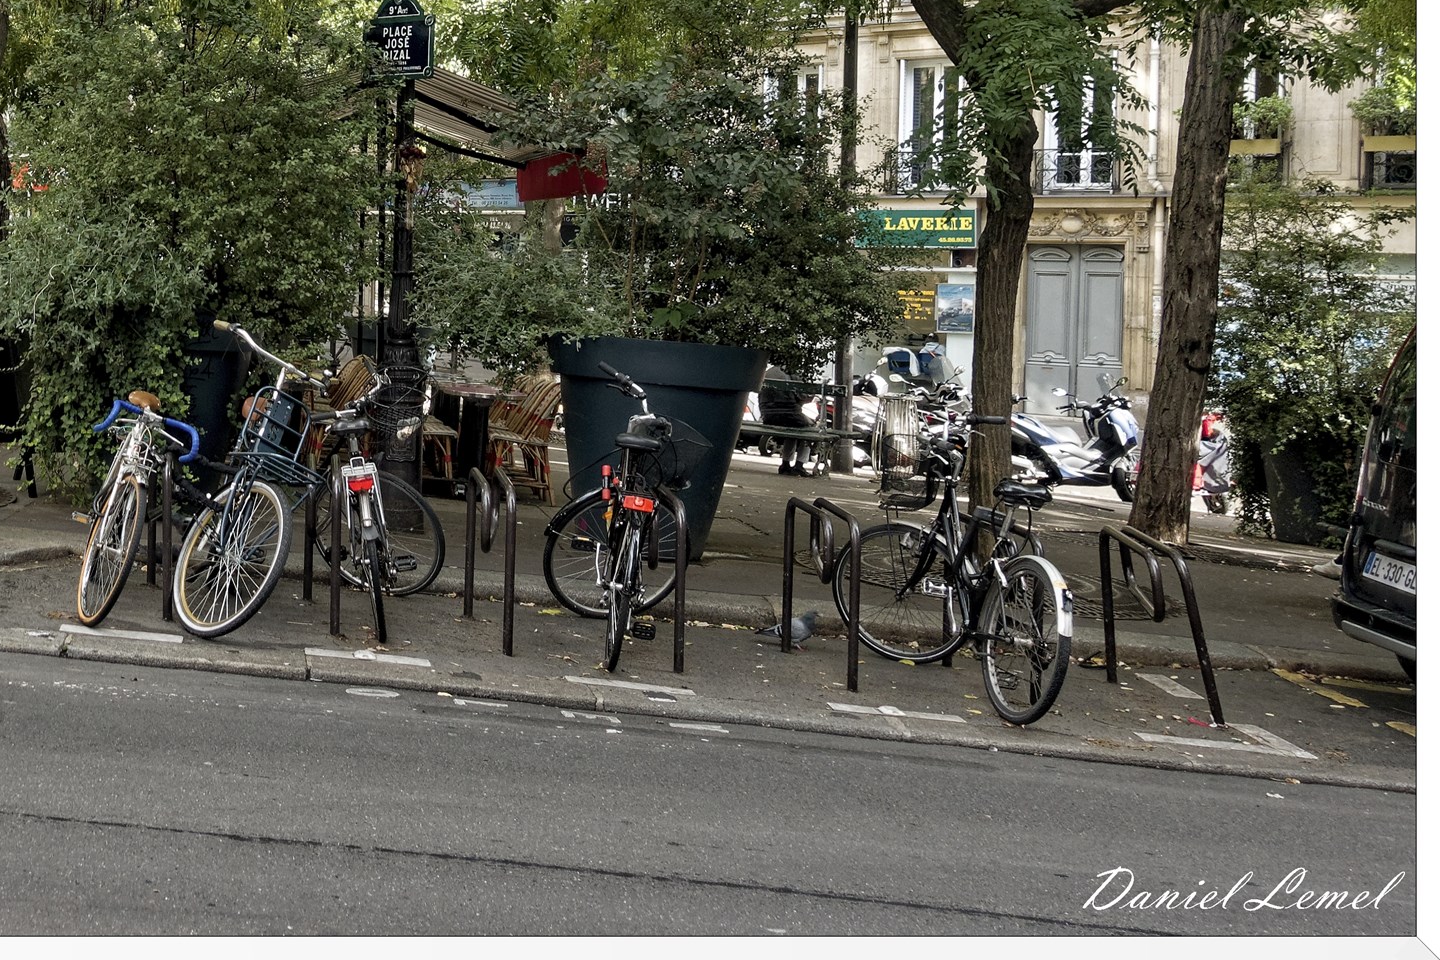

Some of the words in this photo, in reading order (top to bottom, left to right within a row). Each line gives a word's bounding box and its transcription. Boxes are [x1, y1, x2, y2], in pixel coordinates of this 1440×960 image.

[383, 25, 413, 37] PLACE
[385, 35, 410, 49] JOSÉ
[383, 49, 411, 61] RIZAL
[884, 217, 973, 230] LAVERIE
